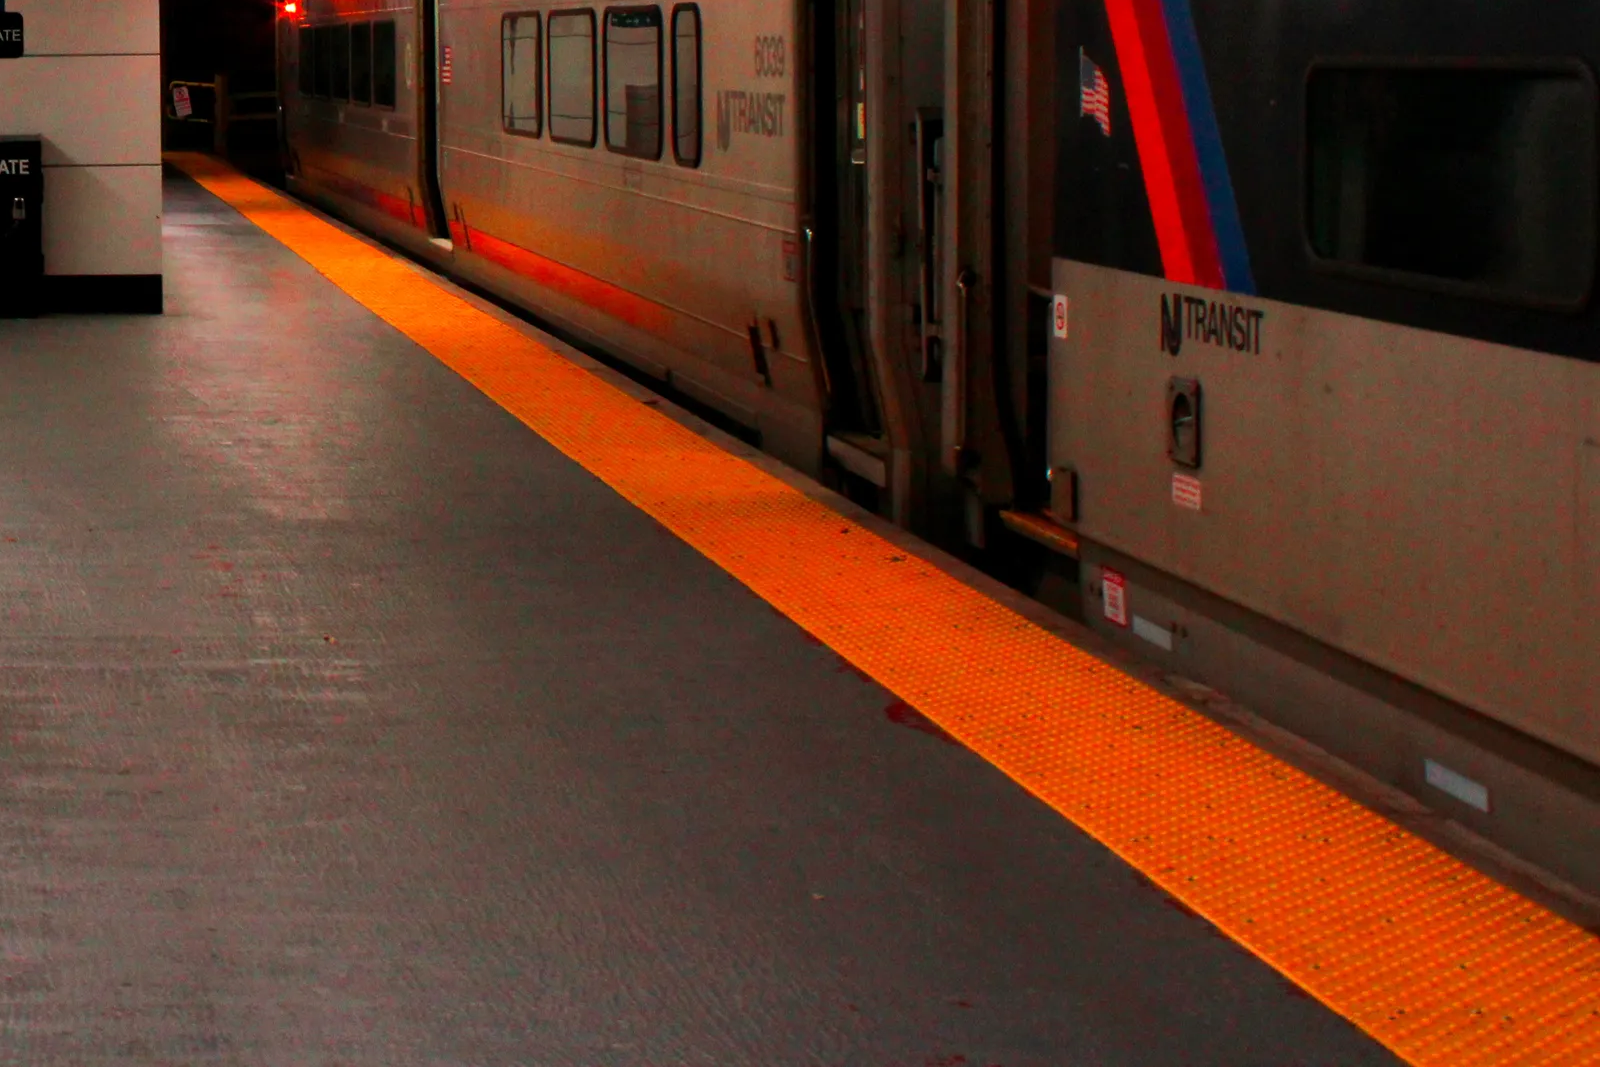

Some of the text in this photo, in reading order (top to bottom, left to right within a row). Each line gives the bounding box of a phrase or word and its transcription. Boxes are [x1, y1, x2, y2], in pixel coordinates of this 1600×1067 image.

[753, 35, 786, 77] 6039
[730, 90, 786, 138] TRANSIT
[1183, 295, 1265, 356] TRANSIT
